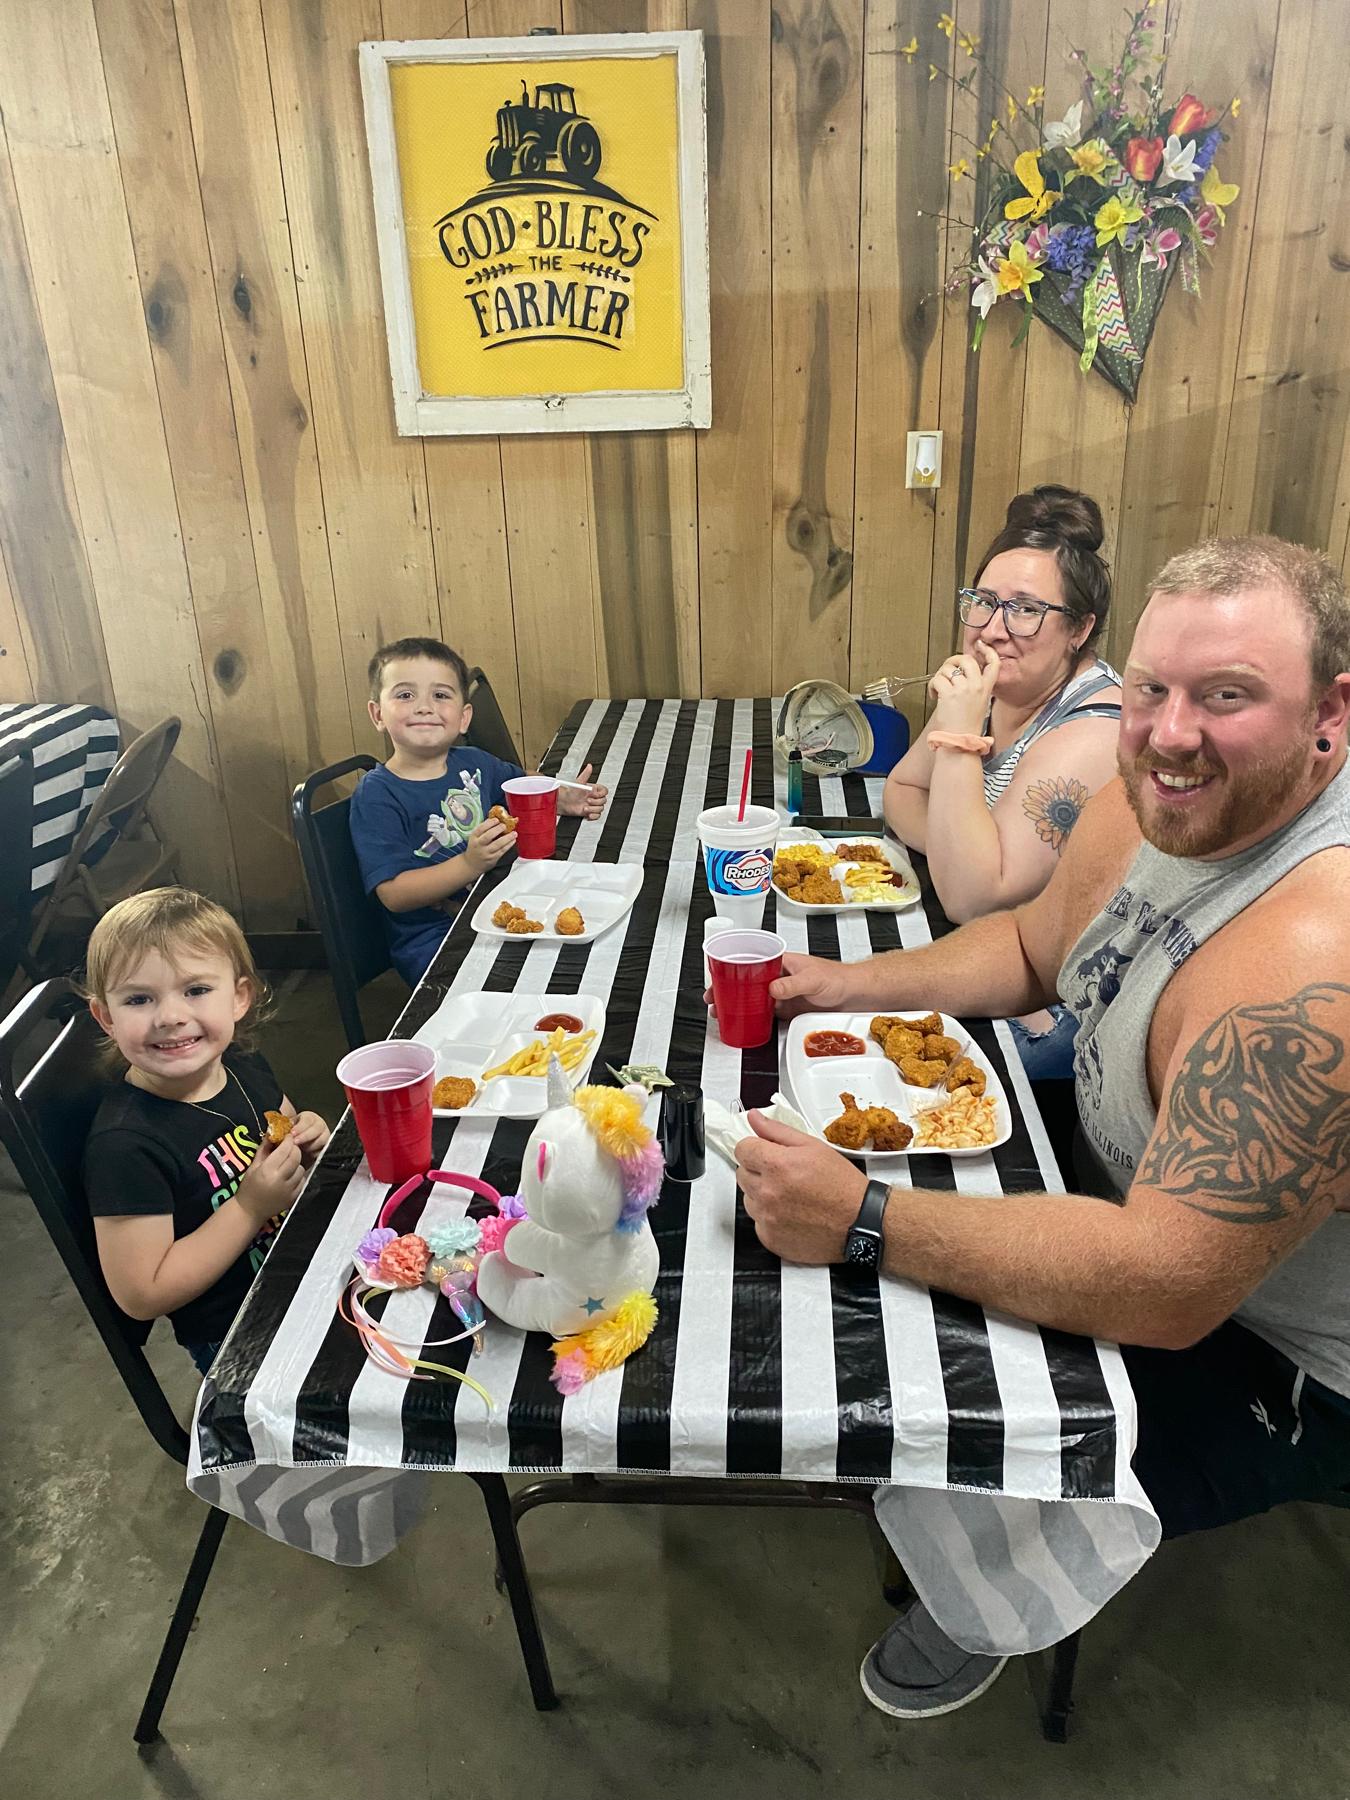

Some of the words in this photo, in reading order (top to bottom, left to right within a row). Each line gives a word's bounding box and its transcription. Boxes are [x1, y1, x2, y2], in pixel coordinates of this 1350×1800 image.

[438, 206, 516, 269] GOD
[534, 200, 650, 268] BLESS
[529, 255, 563, 272] THE
[464, 279, 630, 339] FARMER
[727, 863, 771, 879] RHODES
[197, 1124, 259, 1188] THIS
[1091, 1121, 1134, 1169] ILLINOIS
